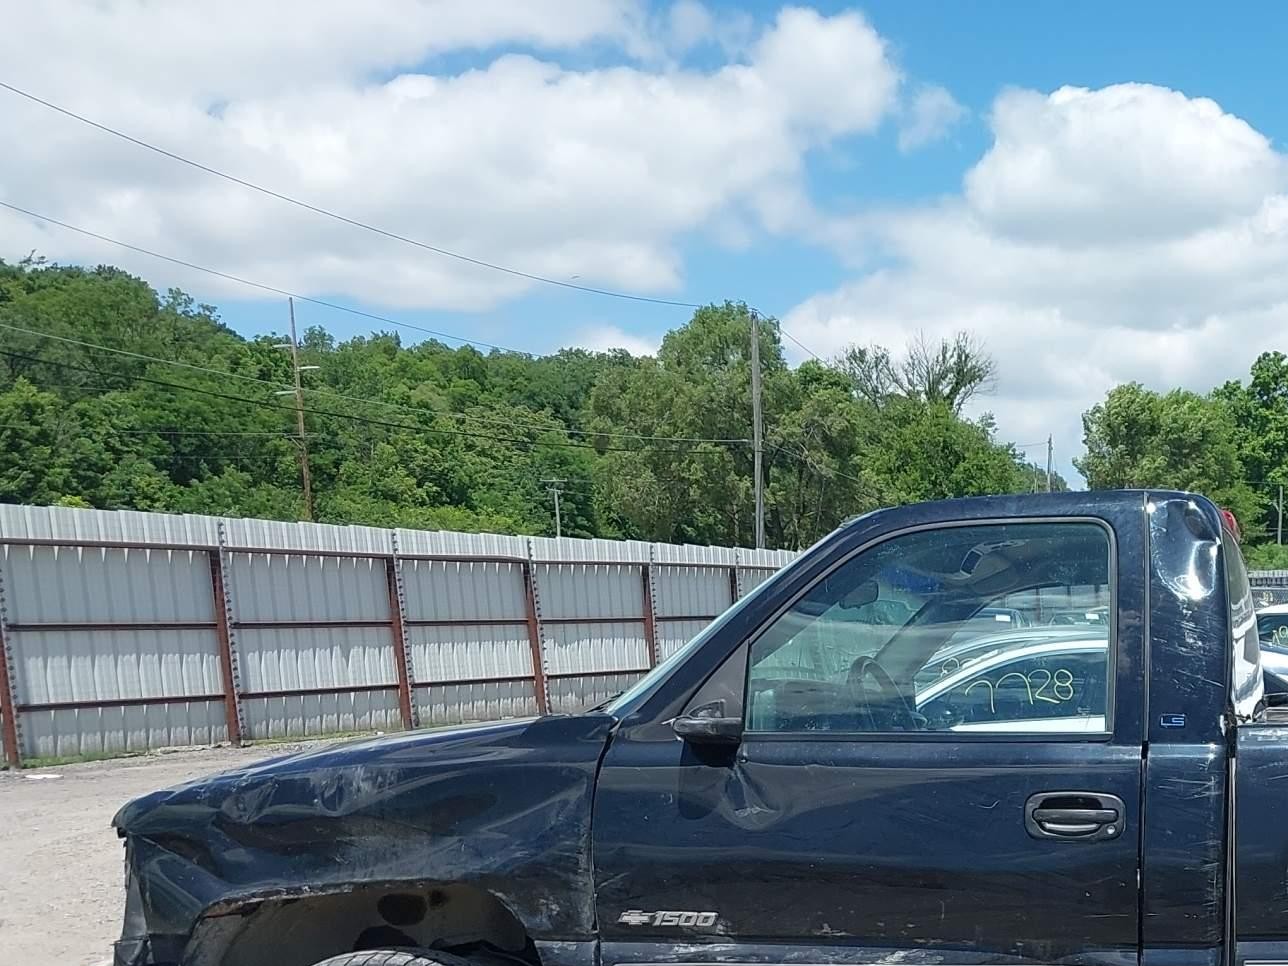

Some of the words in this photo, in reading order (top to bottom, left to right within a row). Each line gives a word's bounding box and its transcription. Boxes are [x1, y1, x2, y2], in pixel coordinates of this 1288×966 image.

[964, 668, 1074, 714] 7728
[1160, 716, 1185, 727] LS
[652, 910, 719, 927] 1500
